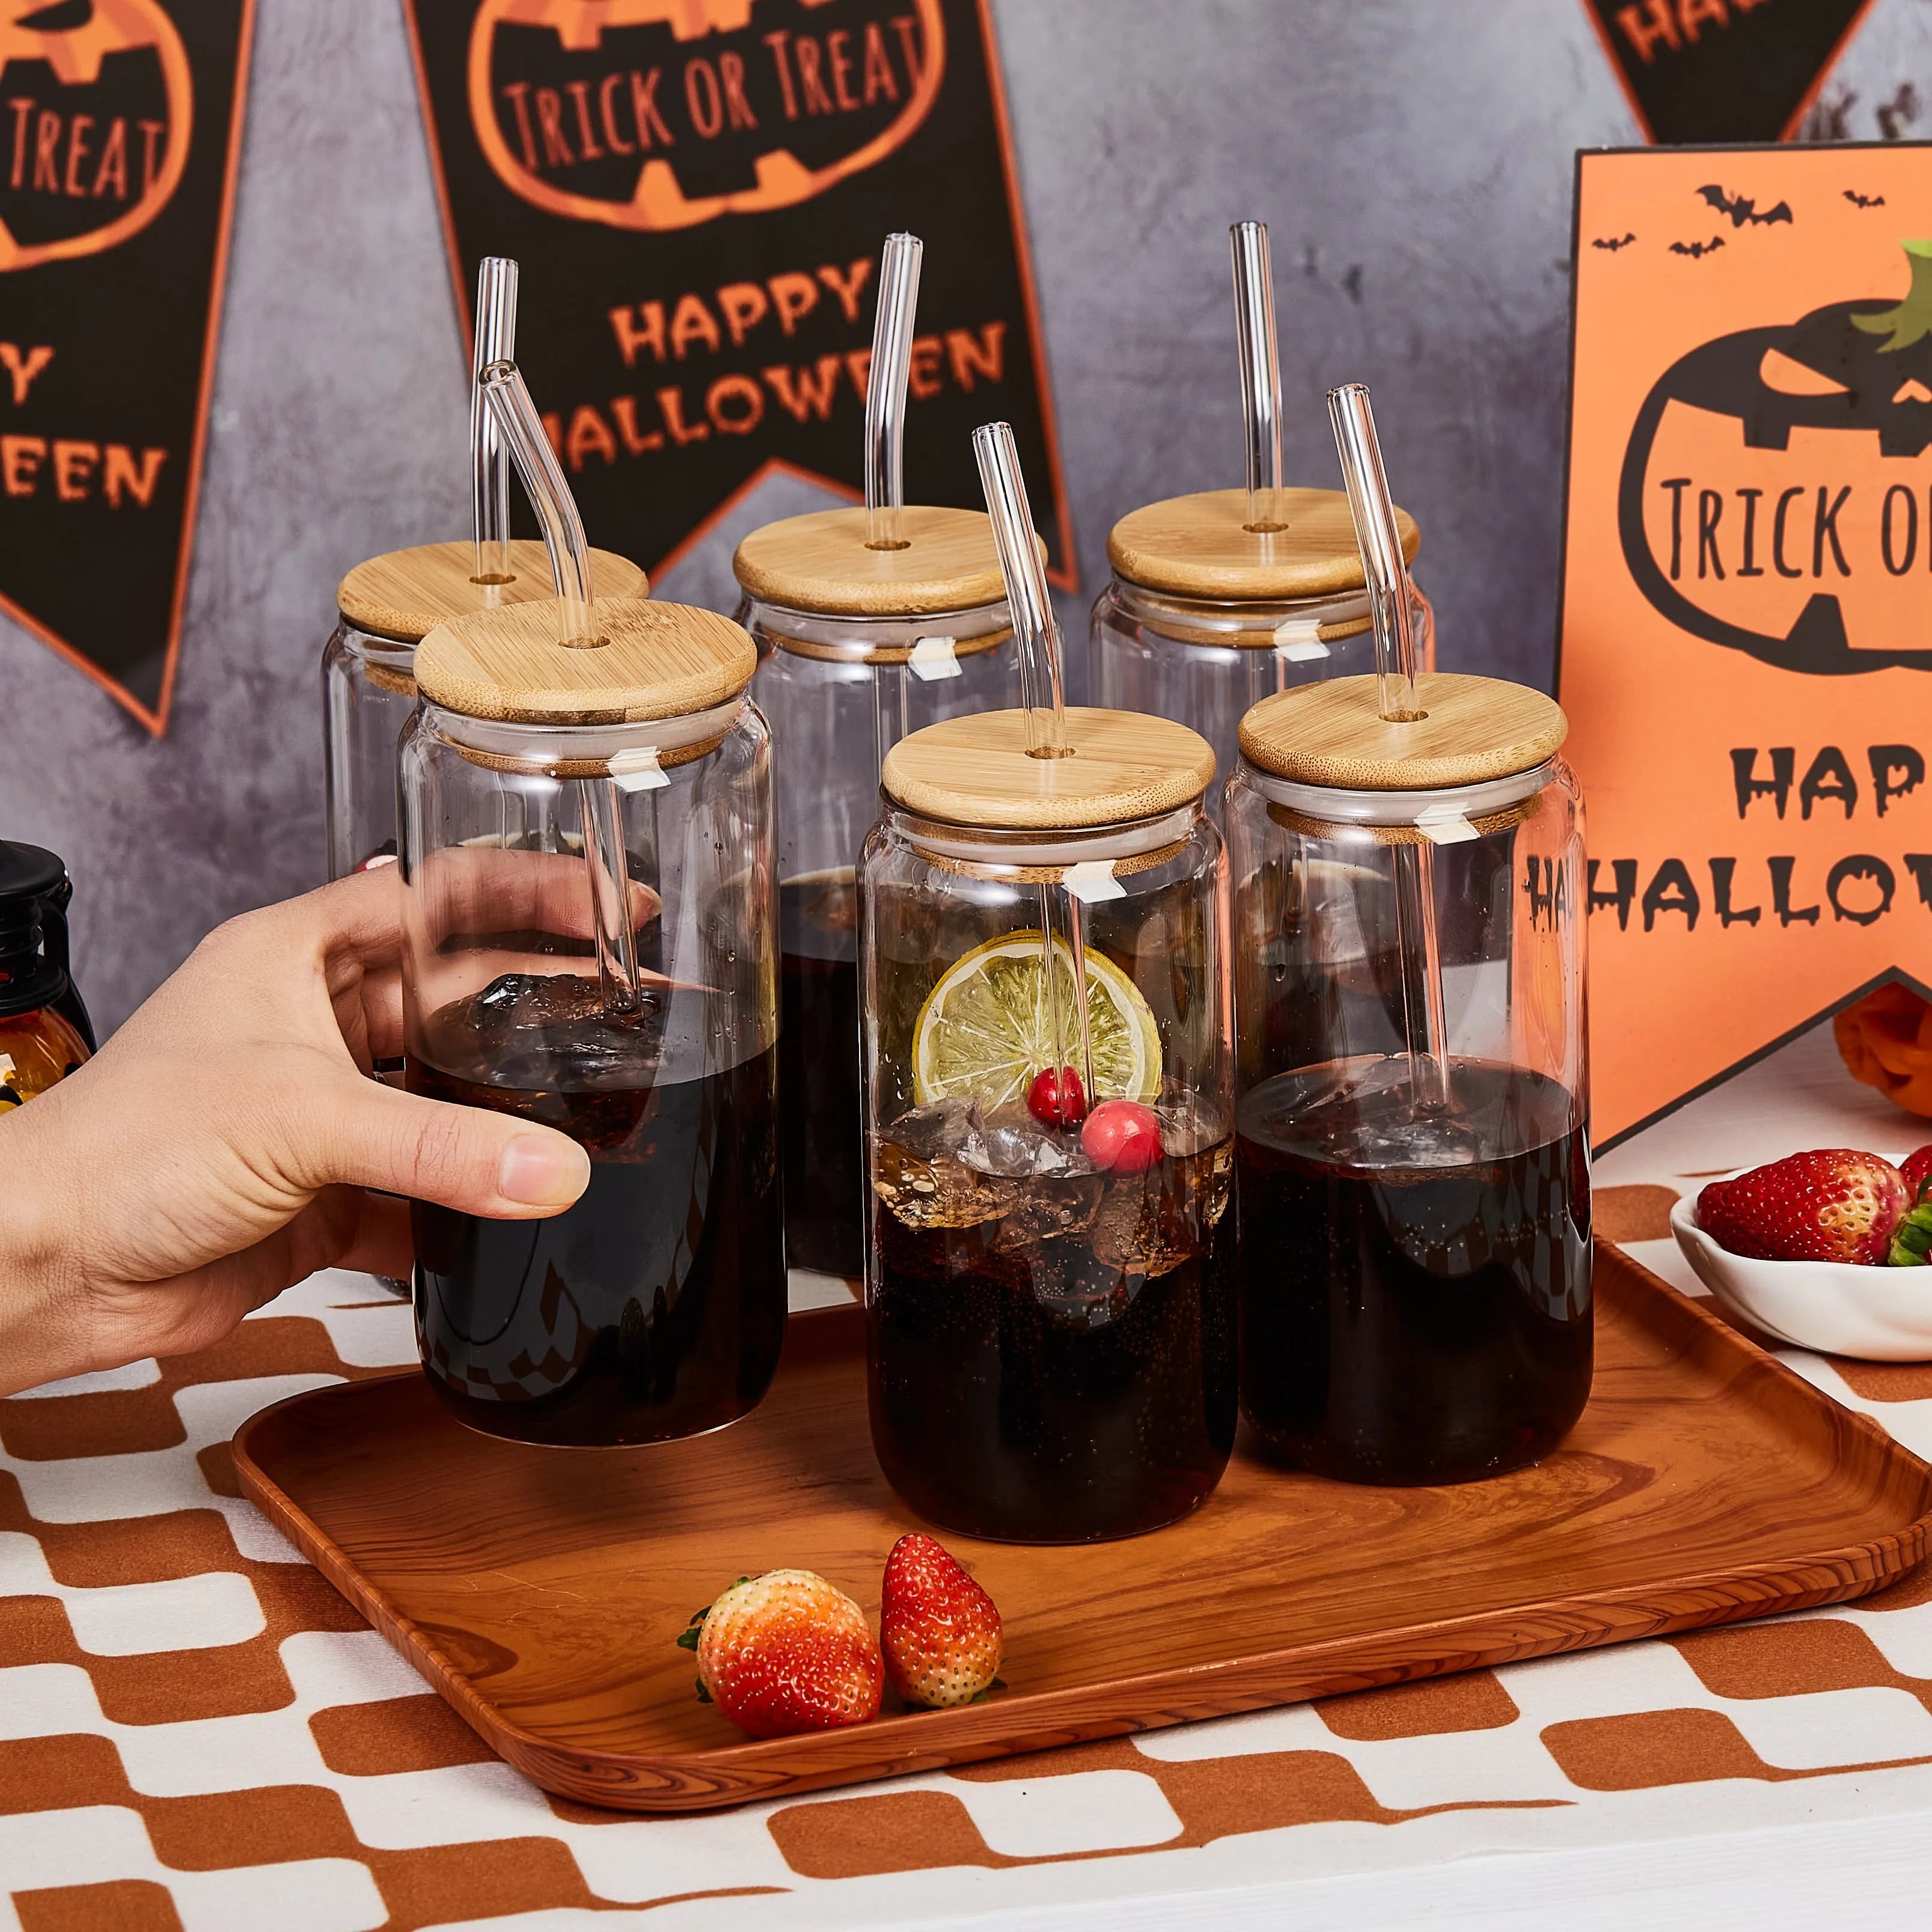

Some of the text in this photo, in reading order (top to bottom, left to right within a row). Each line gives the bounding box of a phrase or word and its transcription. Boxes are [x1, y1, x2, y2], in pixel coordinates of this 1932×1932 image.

[503, 16, 920, 171] TRICK OR TREAT
[8, 97, 164, 200] TREAT
[609, 257, 873, 368] HAPPY
[1660, 478, 1932, 581] TRICK O
